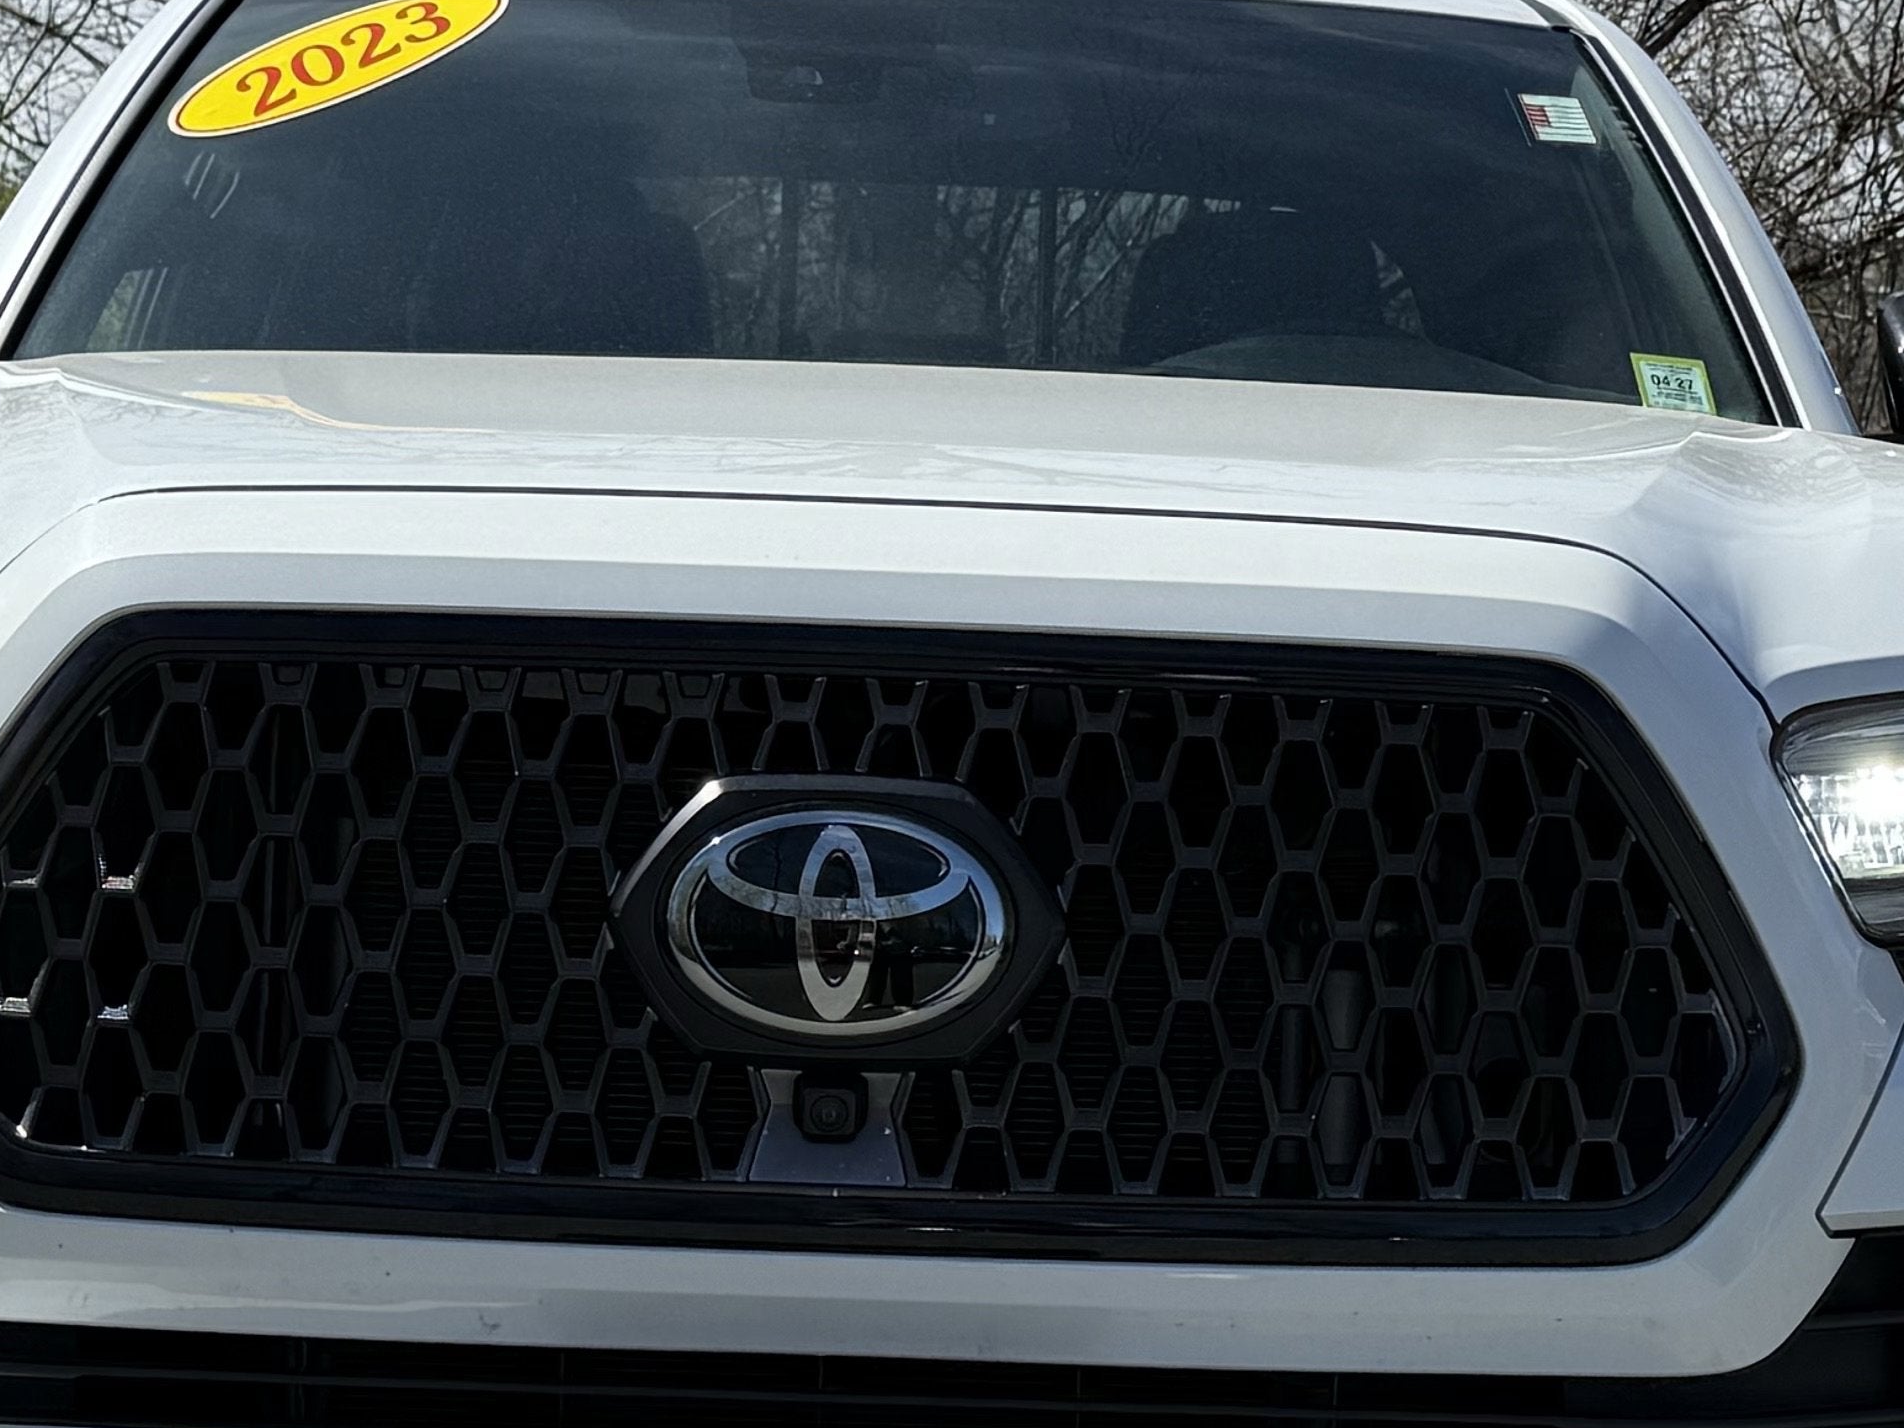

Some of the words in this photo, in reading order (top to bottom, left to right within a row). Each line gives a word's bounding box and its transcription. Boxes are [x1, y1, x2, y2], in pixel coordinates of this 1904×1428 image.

[235, 1, 452, 117] 2023
[1650, 374, 1671, 387] 04
[1675, 377, 1693, 391] 27
